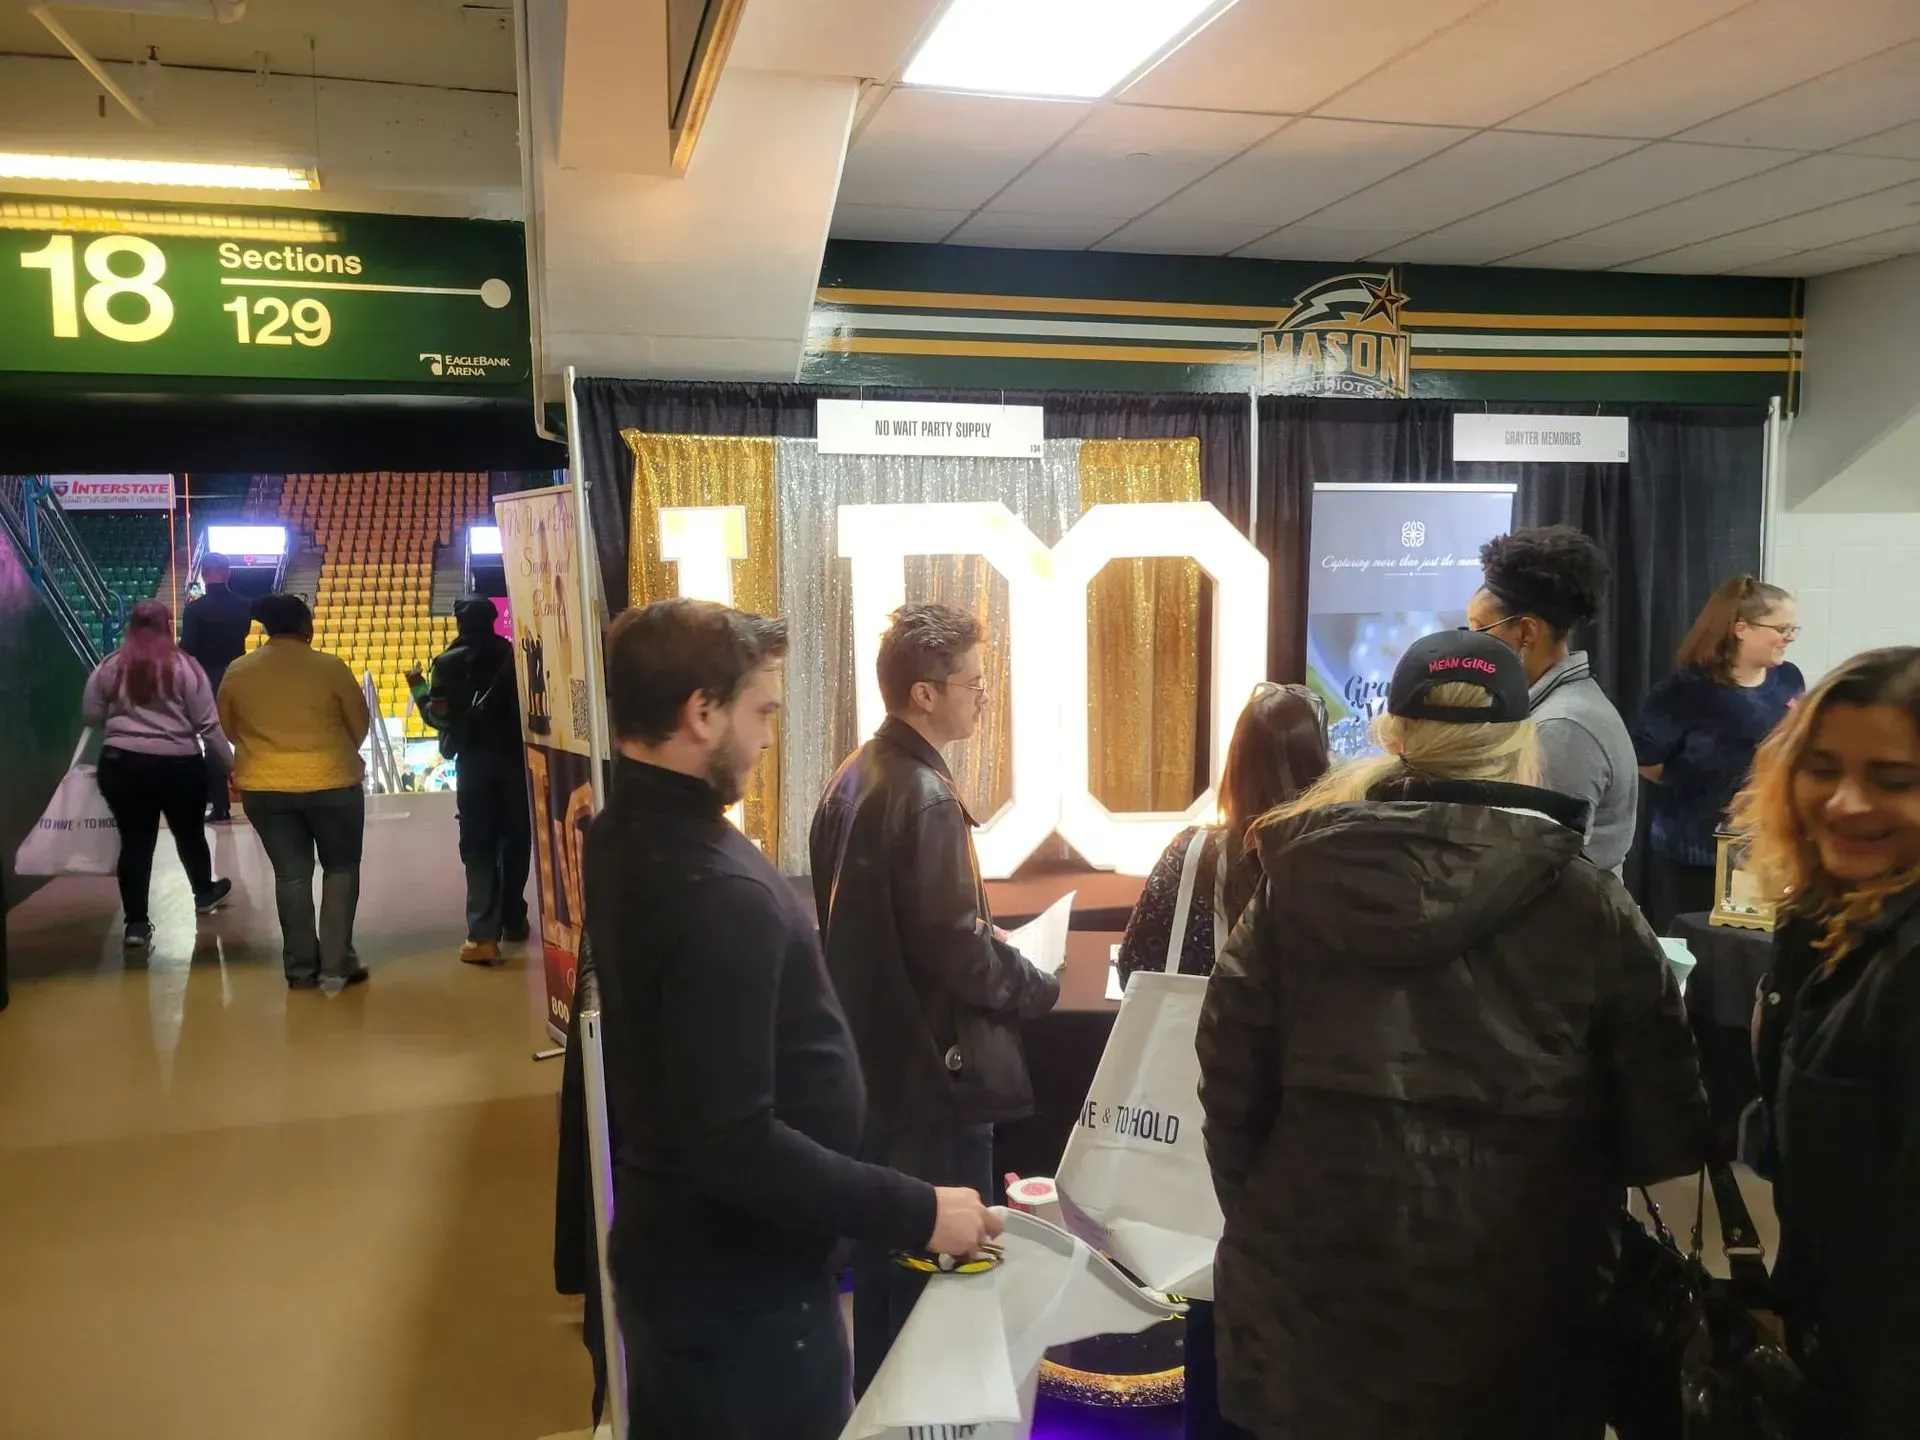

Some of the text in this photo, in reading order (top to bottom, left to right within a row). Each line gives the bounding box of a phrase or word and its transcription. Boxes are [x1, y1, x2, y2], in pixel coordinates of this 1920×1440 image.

[219, 242, 362, 275] Sections
[21, 234, 174, 343] 18
[223, 296, 332, 346] 129
[1263, 331, 1406, 396] MASON
[875, 420, 991, 438] NO WAIT PARTY SUPPLY
[1504, 431, 1581, 446] GRAYTER MEMORIES
[1030, 444, 1041, 453] 134
[71, 481, 168, 494] INTERSTATE
[1321, 554, 1369, 572] Capturing
[1371, 558, 1396, 568] more
[1399, 554, 1418, 568] than
[1416, 556, 1439, 571] just
[1440, 553, 1454, 567] the
[1428, 657, 1497, 674] MEAN GIRLS
[1344, 675, 1391, 709] Gra
[551, 996, 570, 1024] 800
[1078, 1100, 1097, 1129] VE
[1102, 1107, 1112, 1124] &
[1128, 1107, 1180, 1145] HOLD
